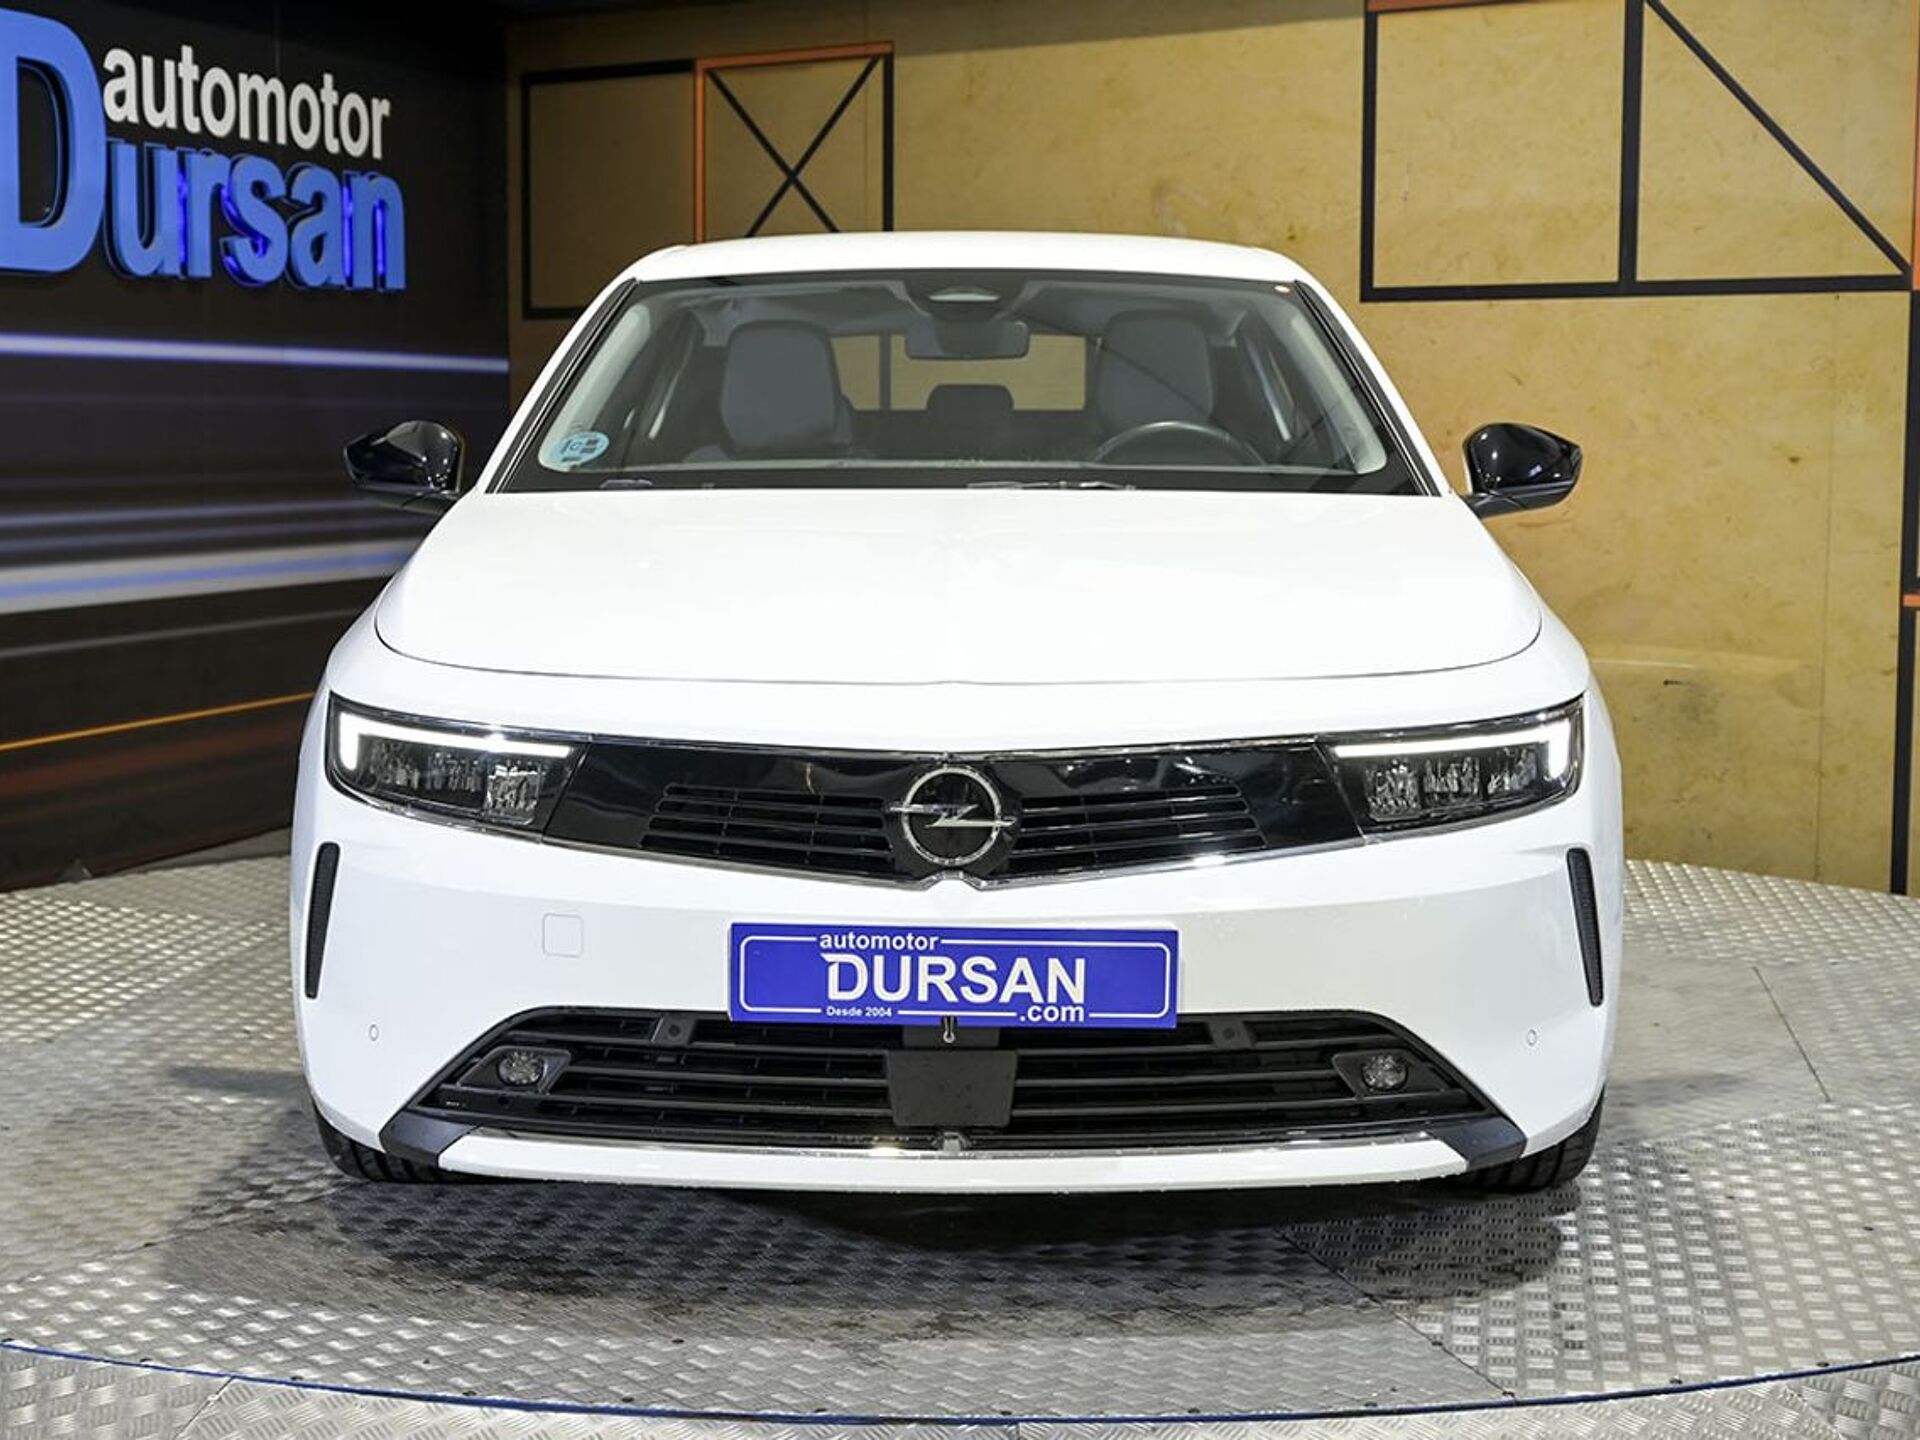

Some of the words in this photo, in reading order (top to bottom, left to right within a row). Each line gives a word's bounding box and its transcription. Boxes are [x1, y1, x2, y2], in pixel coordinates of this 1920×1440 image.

[103, 45, 391, 159] automotor
[0, 8, 406, 290] Dursan
[820, 932, 938, 951] automotor
[820, 953, 1085, 1004] DURSAN
[826, 1006, 862, 1017] Desde
[865, 1007, 892, 1017] 2004
[1019, 1003, 1084, 1022] .com
